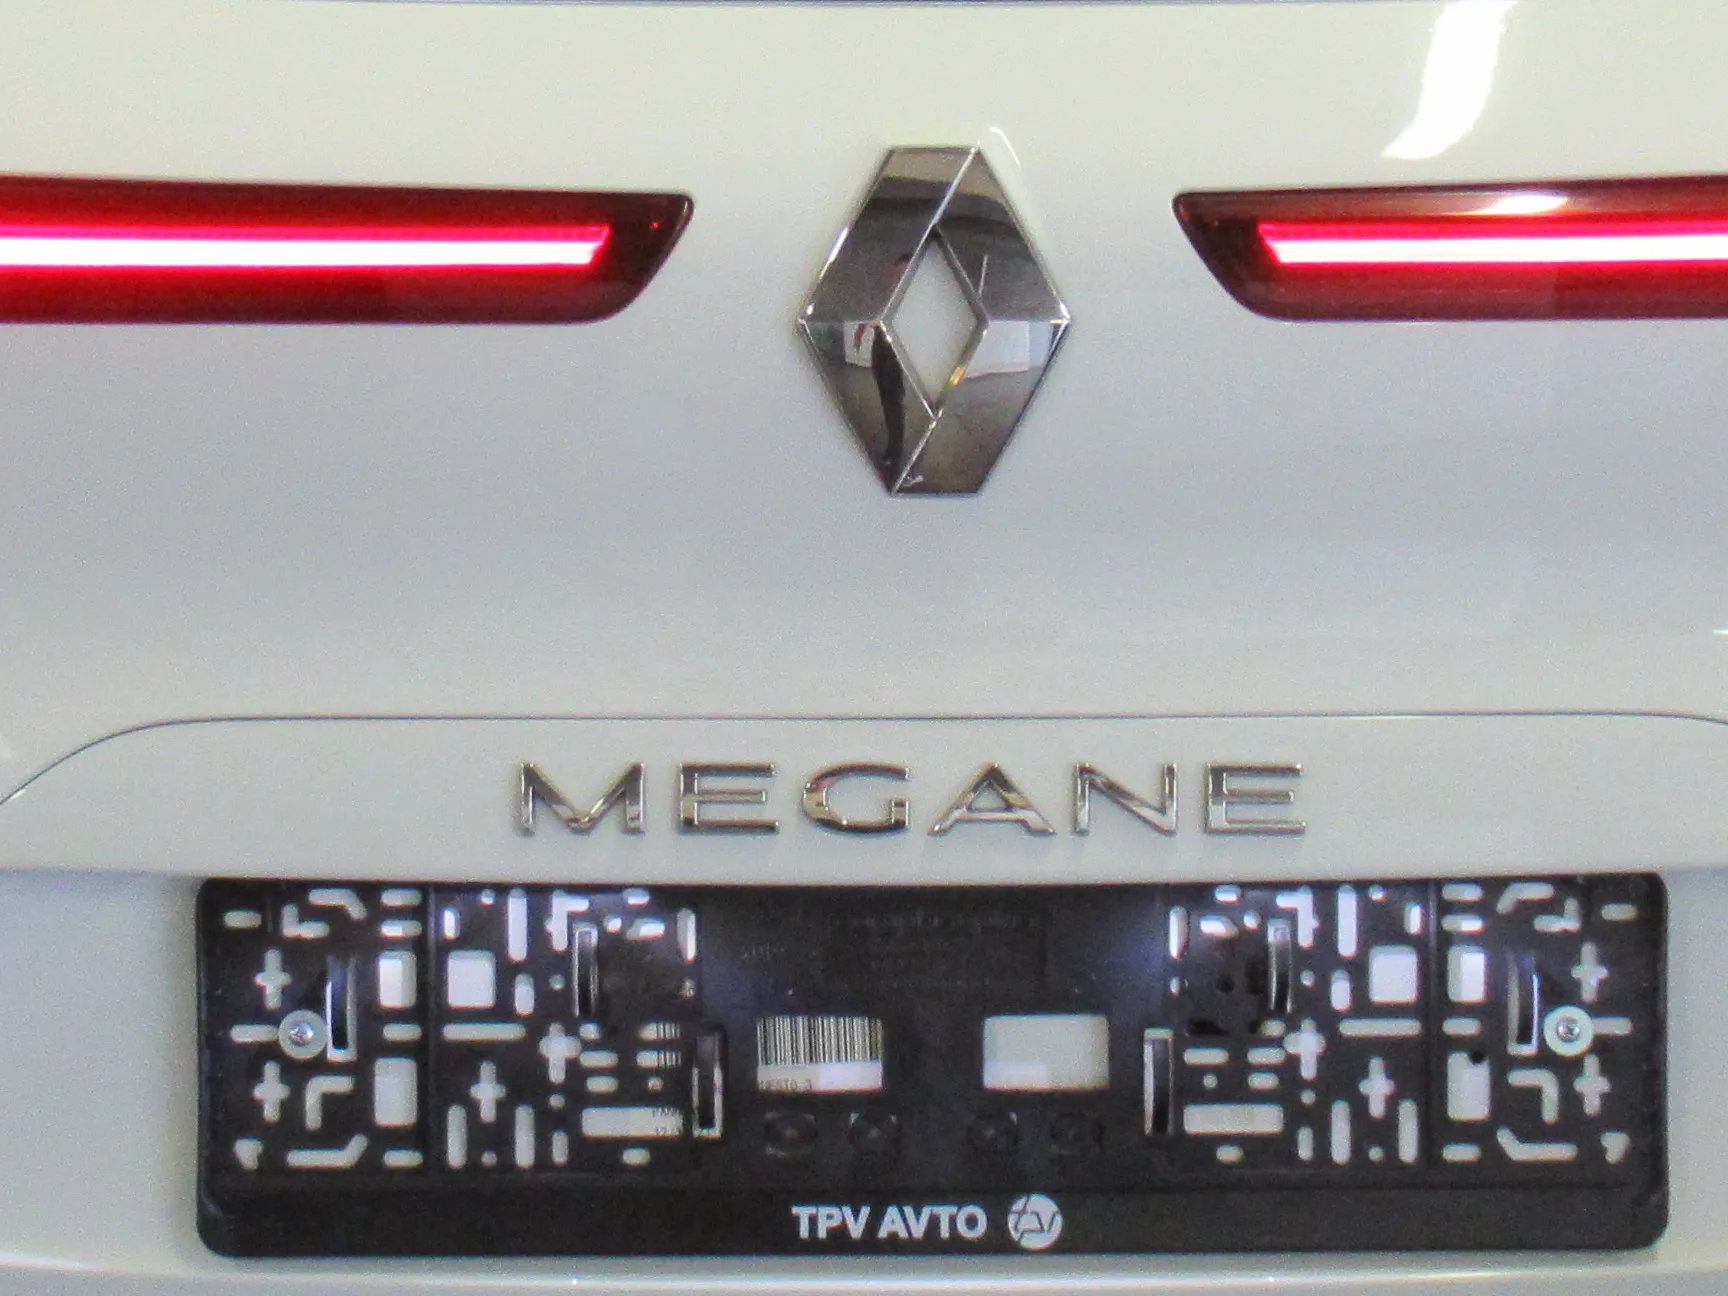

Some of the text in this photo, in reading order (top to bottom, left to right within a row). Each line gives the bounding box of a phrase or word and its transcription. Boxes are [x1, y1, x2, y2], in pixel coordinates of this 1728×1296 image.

[518, 761, 1307, 836] MEGANE
[790, 1204, 871, 1240] TPV
[876, 1204, 988, 1240] AVTO
